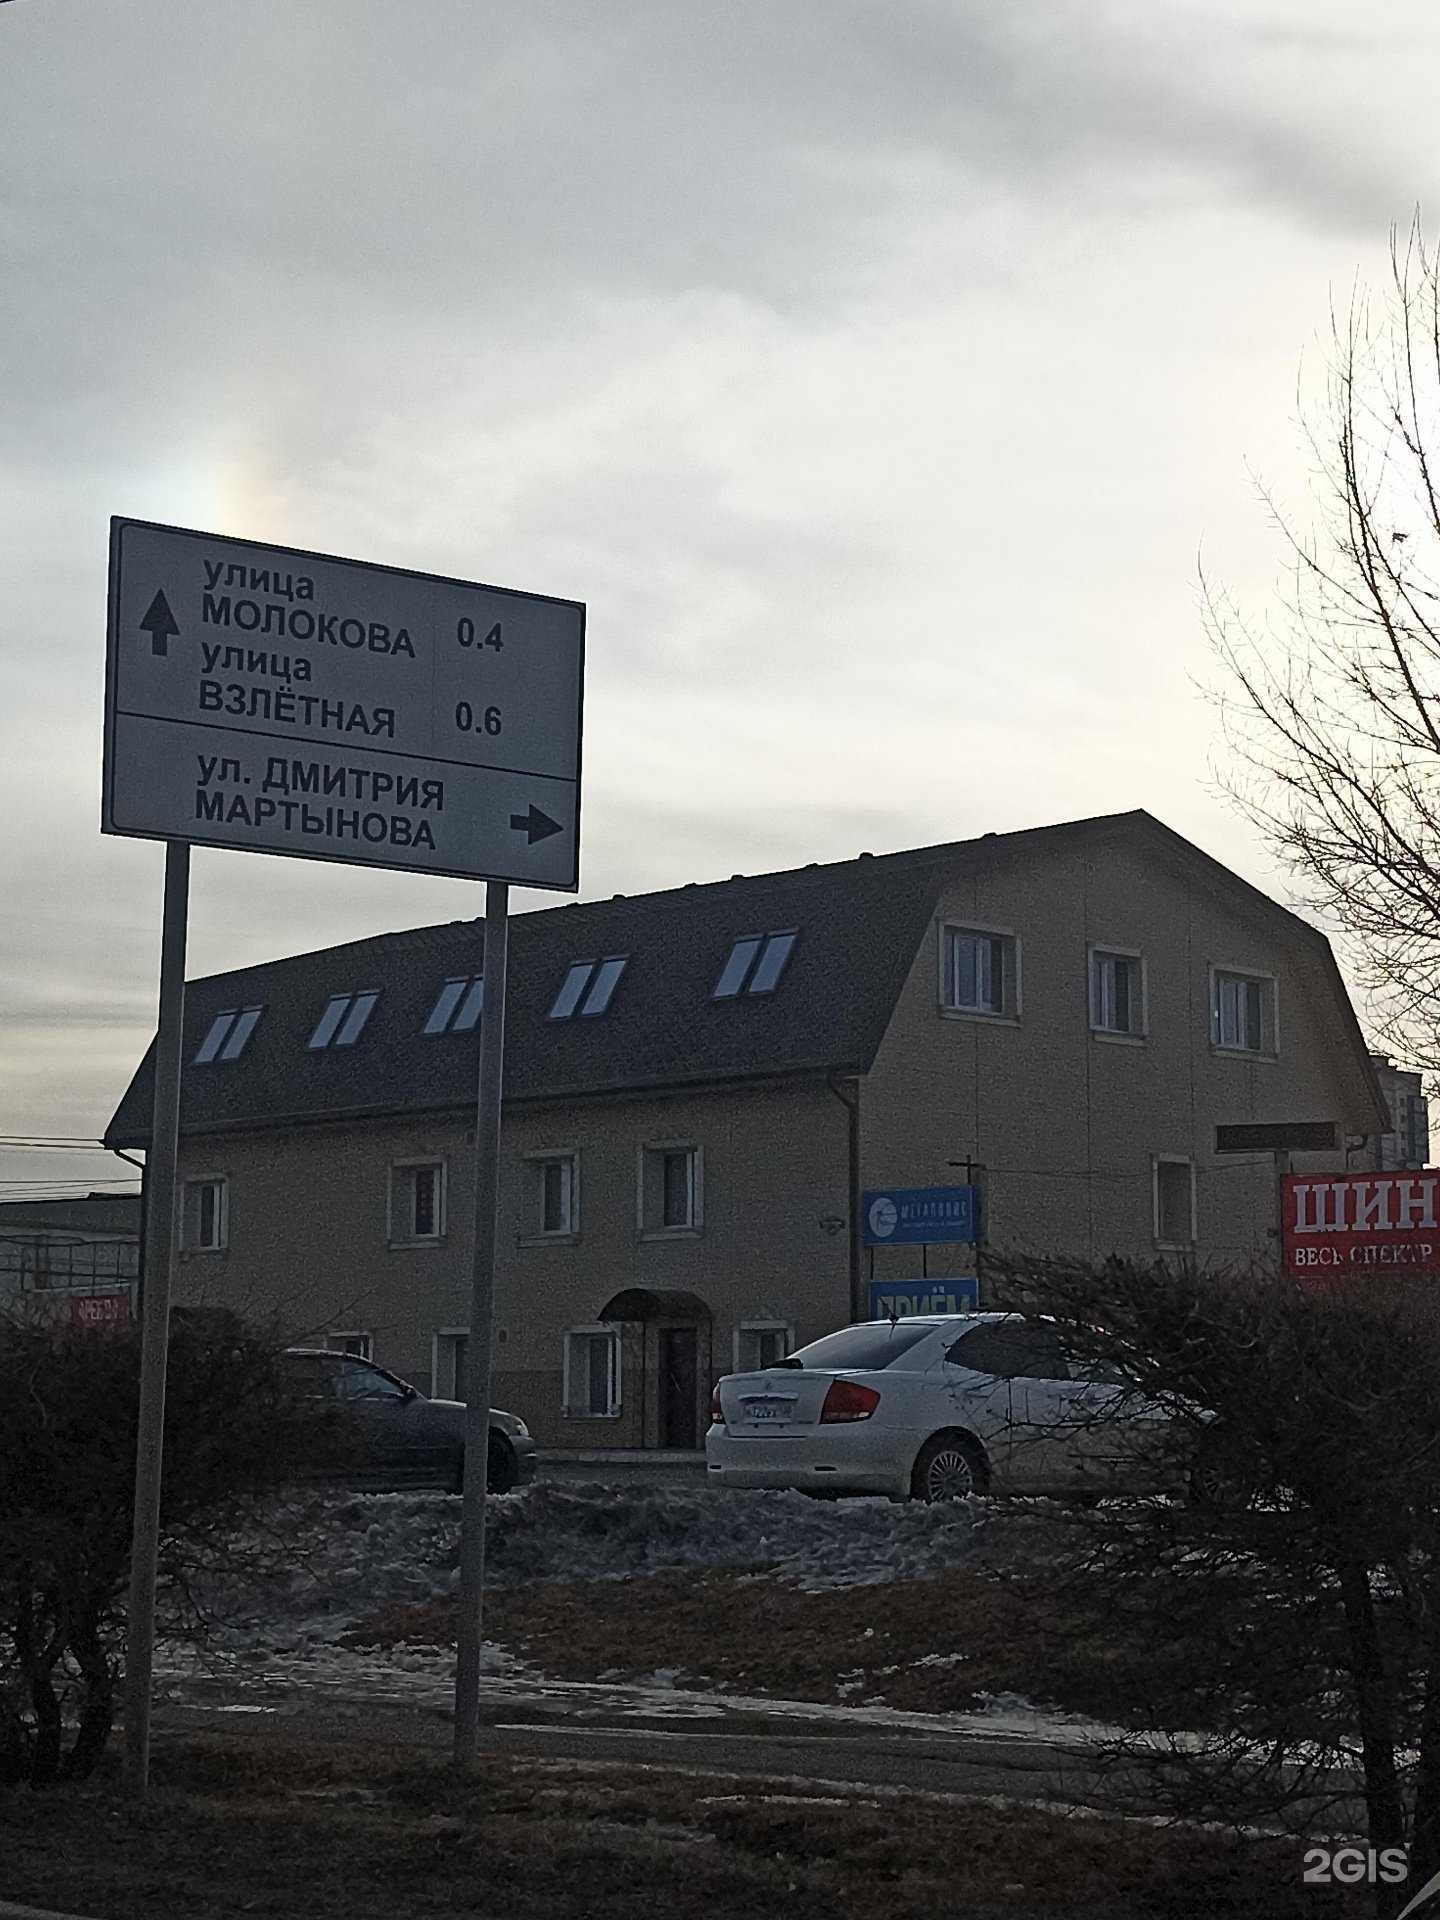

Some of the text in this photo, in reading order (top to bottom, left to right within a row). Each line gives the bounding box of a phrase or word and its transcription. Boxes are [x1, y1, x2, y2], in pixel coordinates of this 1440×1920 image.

[203, 559, 314, 601] улица
[202, 594, 415, 657] МОЛОКОВА
[456, 617, 504, 652] 0.4
[201, 641, 312, 683] улица
[199, 679, 396, 738] ВЗЛЁТНАЯ
[455, 701, 502, 735] 0.6
[197, 755, 444, 811] ул. ДМИТРИЯ
[195, 789, 436, 851] МАРТЫНОВА
[1293, 1178, 1438, 1233] ШИН
